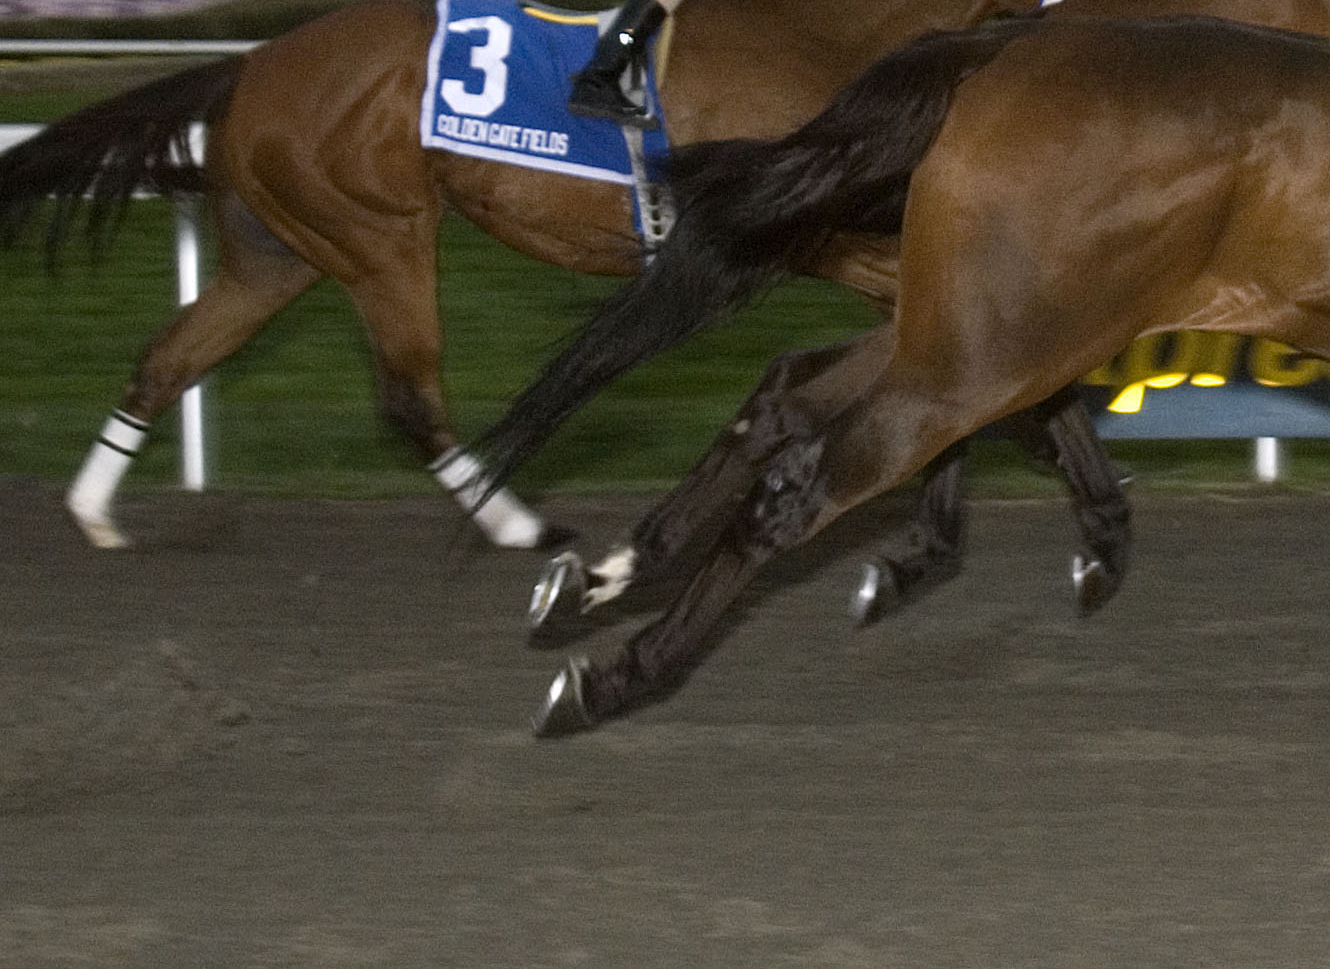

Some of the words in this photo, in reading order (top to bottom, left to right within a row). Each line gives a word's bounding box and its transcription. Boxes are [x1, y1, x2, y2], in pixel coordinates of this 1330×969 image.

[440, 15, 512, 117] 3
[436, 114, 488, 145] GOLDEN
[489, 122, 521, 148] GATE
[520, 128, 569, 156] FIELDS
